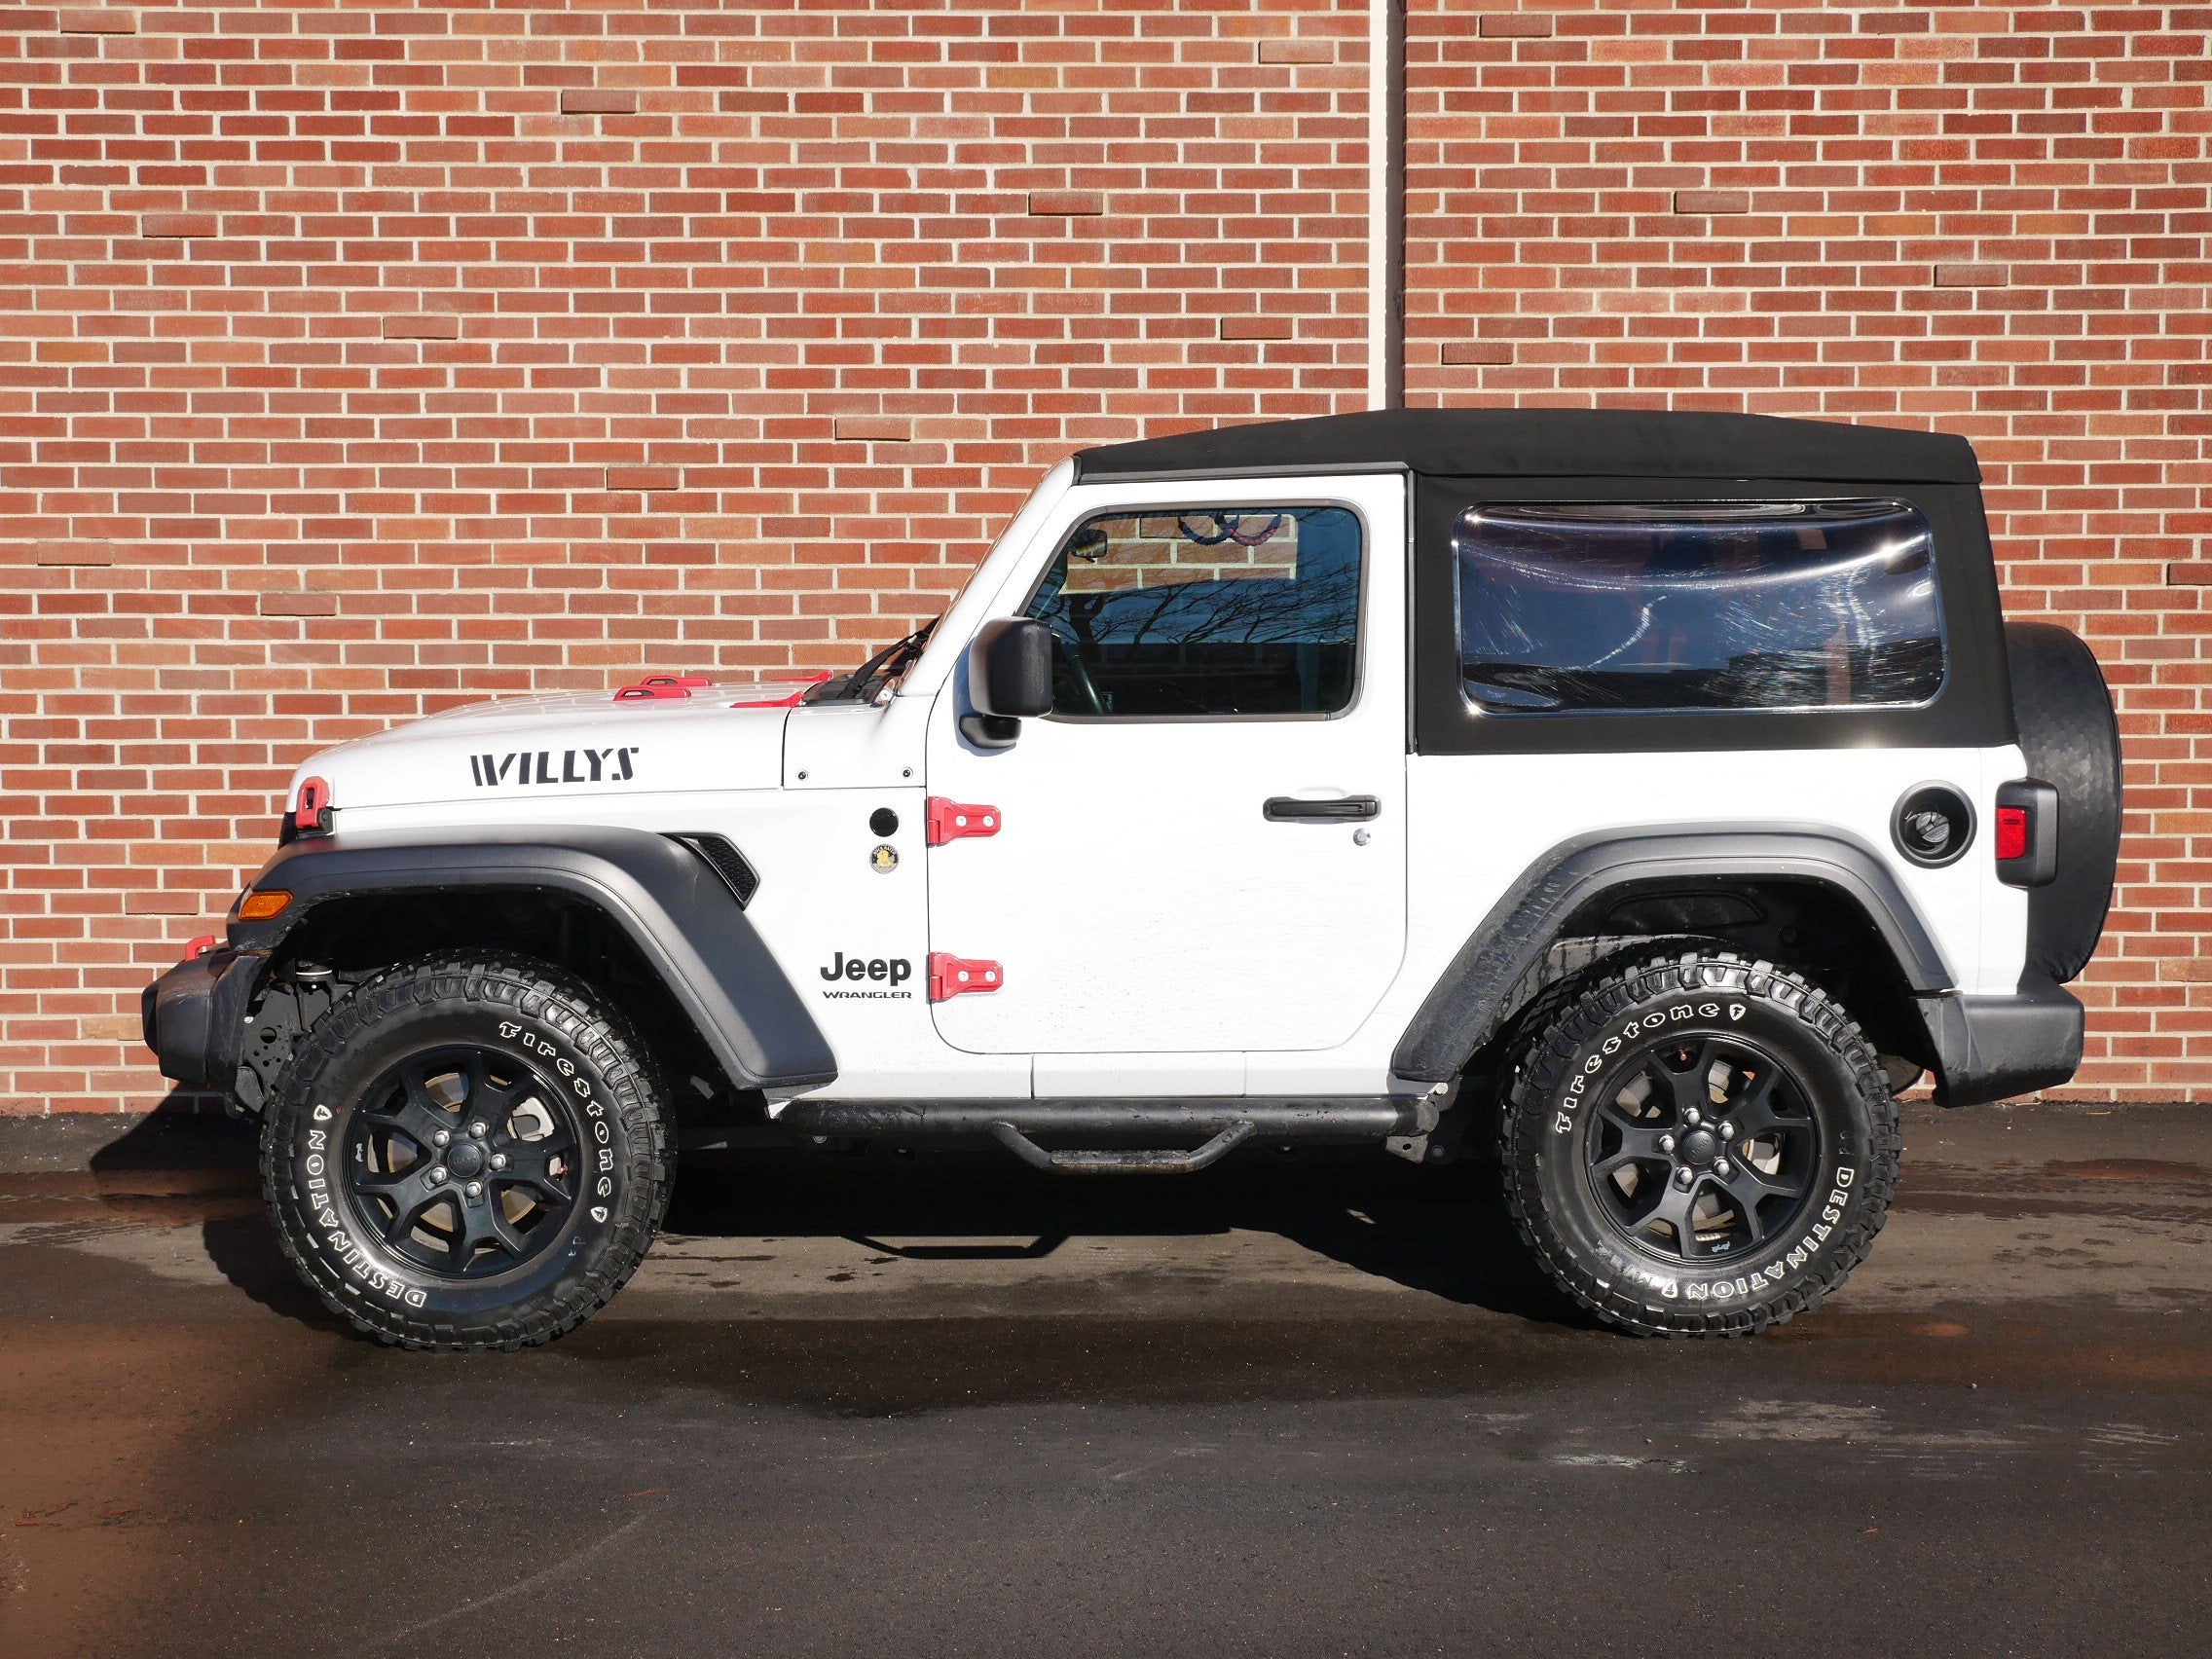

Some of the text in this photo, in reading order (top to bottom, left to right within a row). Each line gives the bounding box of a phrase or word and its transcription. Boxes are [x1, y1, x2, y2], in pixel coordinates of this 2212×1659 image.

[470, 747, 639, 786] WILLYS
[820, 952, 911, 986] Jeep
[306, 1129, 426, 1308] DESTINATION
[1687, 1166, 1855, 1299] DESTINATION
